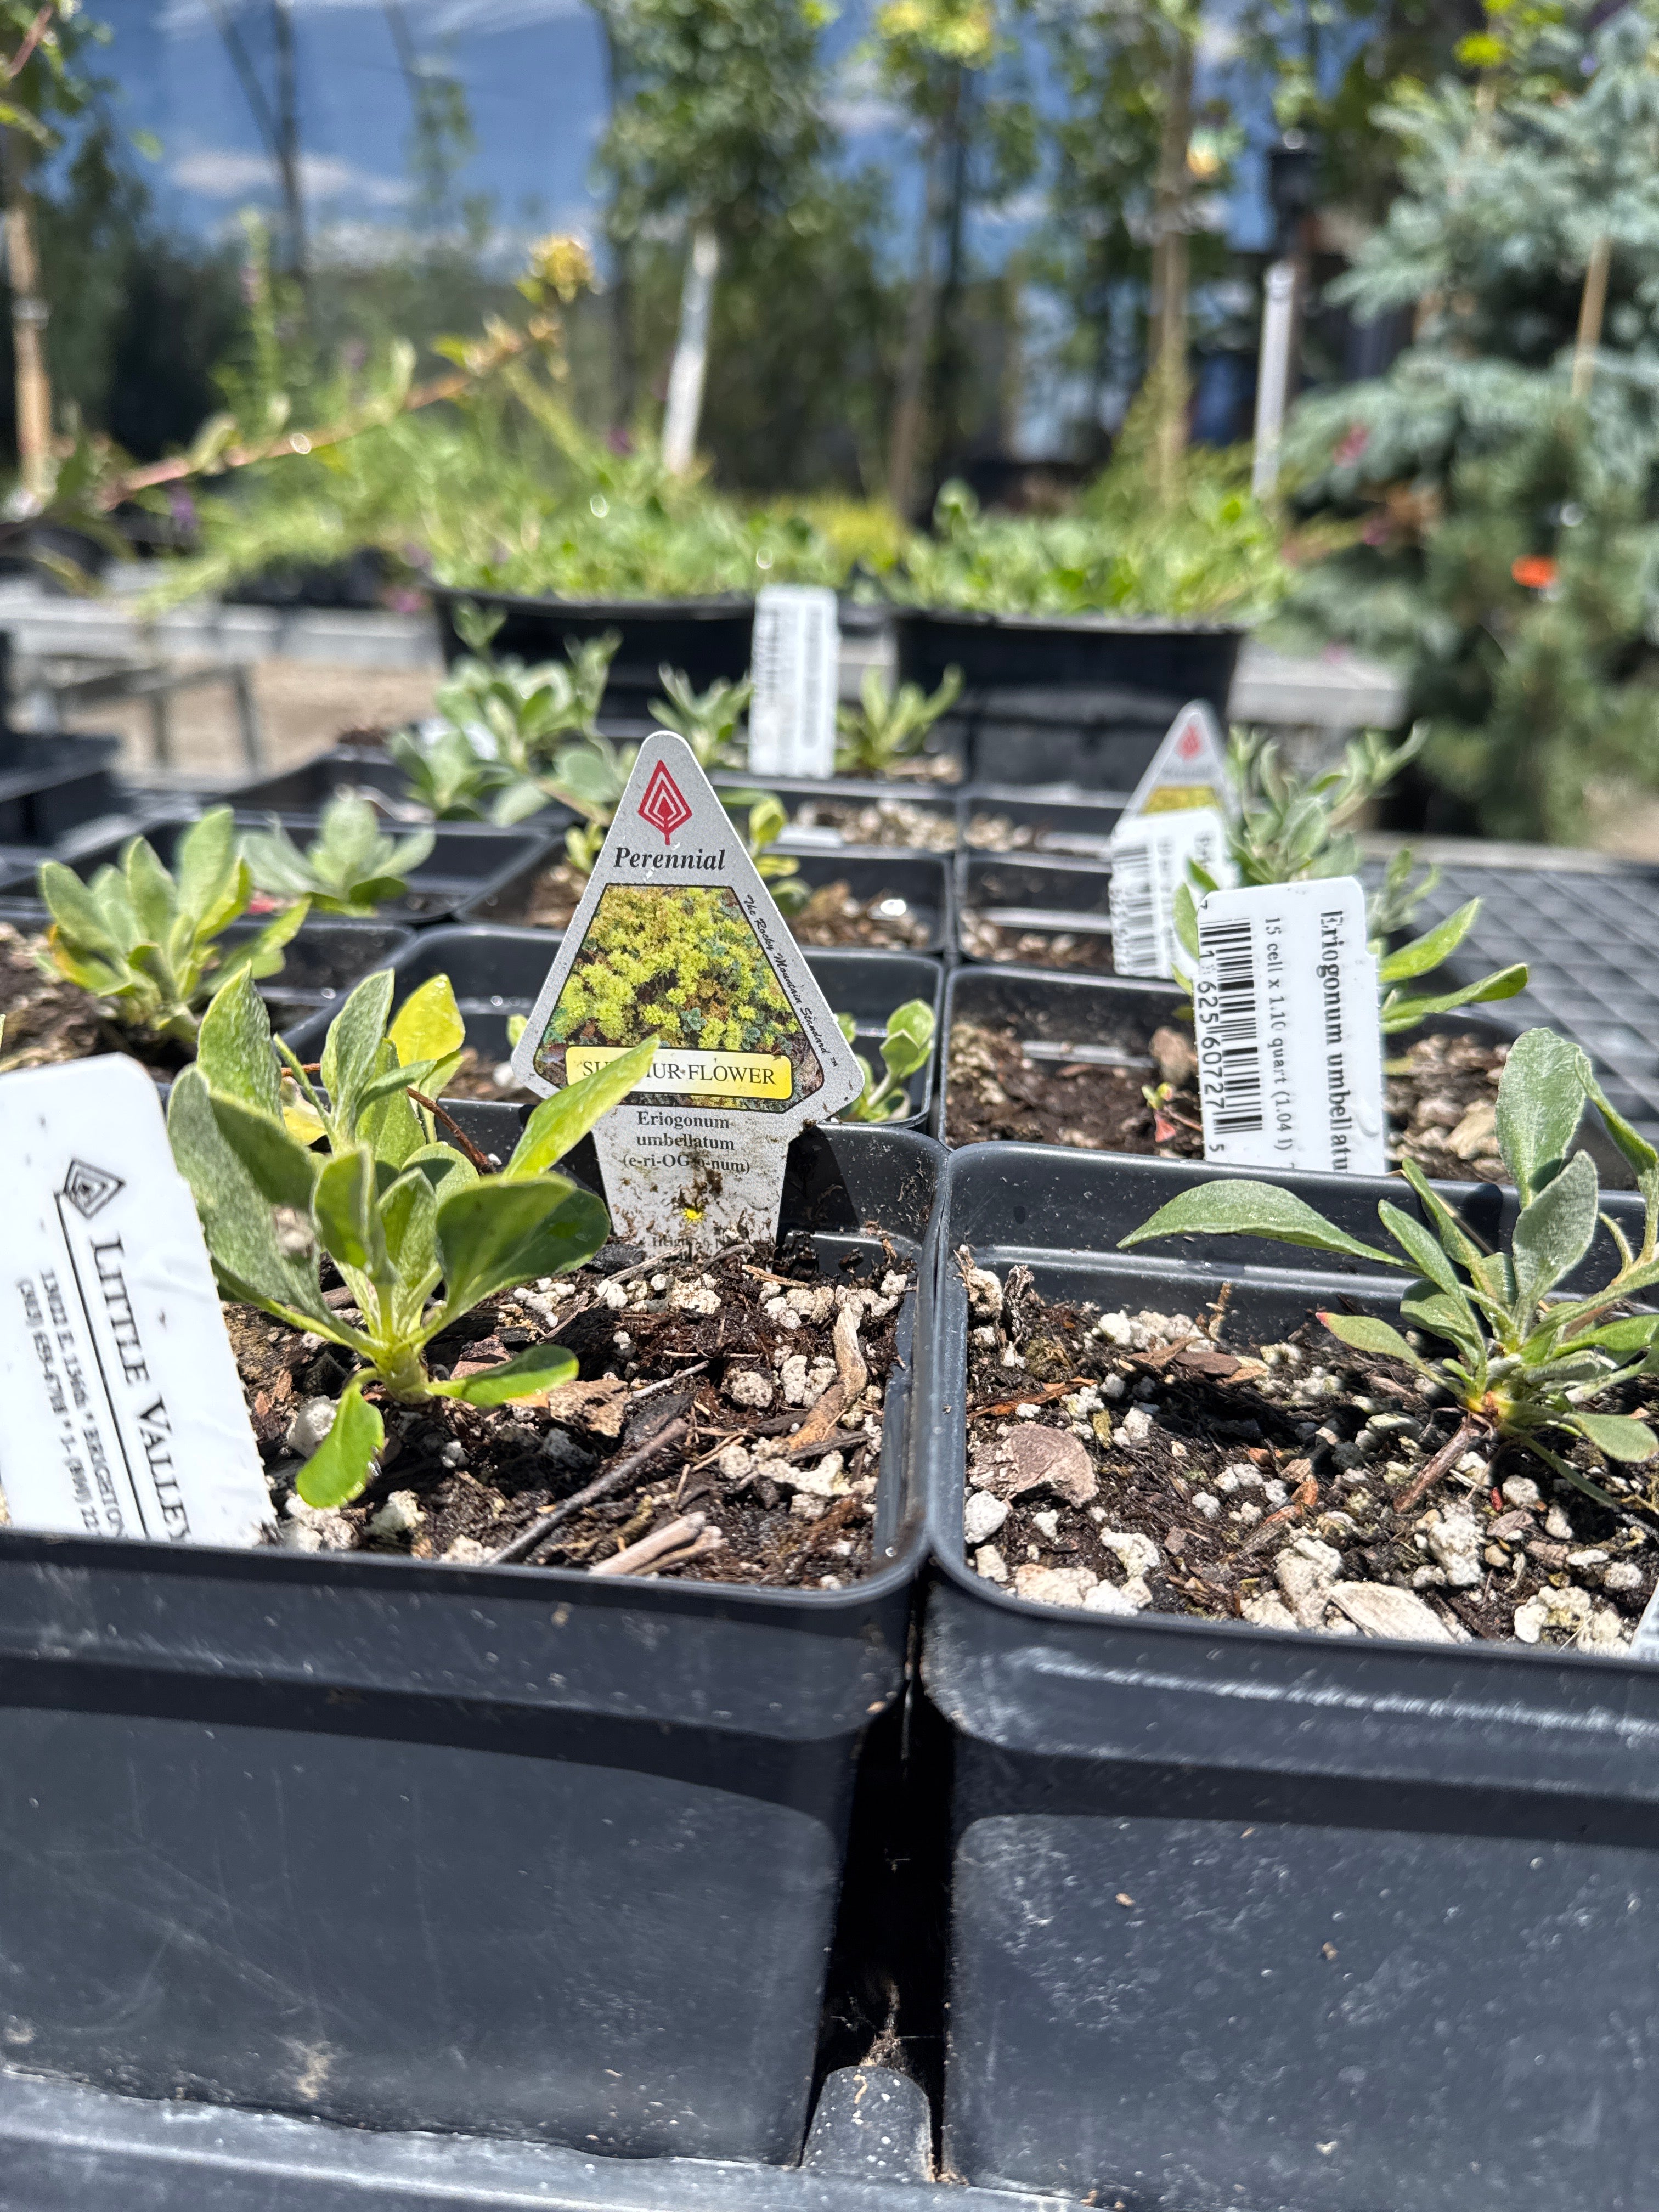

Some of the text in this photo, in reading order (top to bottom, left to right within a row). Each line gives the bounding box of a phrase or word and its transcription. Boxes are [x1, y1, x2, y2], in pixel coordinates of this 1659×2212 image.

[612, 847, 726, 871] Perennial
[1265, 917, 1282, 935] 15
[1266, 943, 1283, 973] cell
[743, 894, 756, 916] The
[755, 917, 775, 951] Rocky
[773, 952, 802, 1005] Mountain
[800, 1007, 831, 1056] Standard
[1267, 978, 1280, 989] x
[1269, 996, 1286, 1031] 1.10
[1316, 911, 1352, 1173] Eriogonum umbellatu
[583, 1060, 777, 1085] SUUR FLOWER
[1200, 1036, 1225, 1109] 60727
[1267, 1037, 1288, 1084] quart
[636, 1111, 730, 1130] Eriogonum
[1270, 1091, 1292, 1132] (1.04
[636, 1133, 735, 1150] umbellatum
[1208, 1143, 1225, 1152] 5
